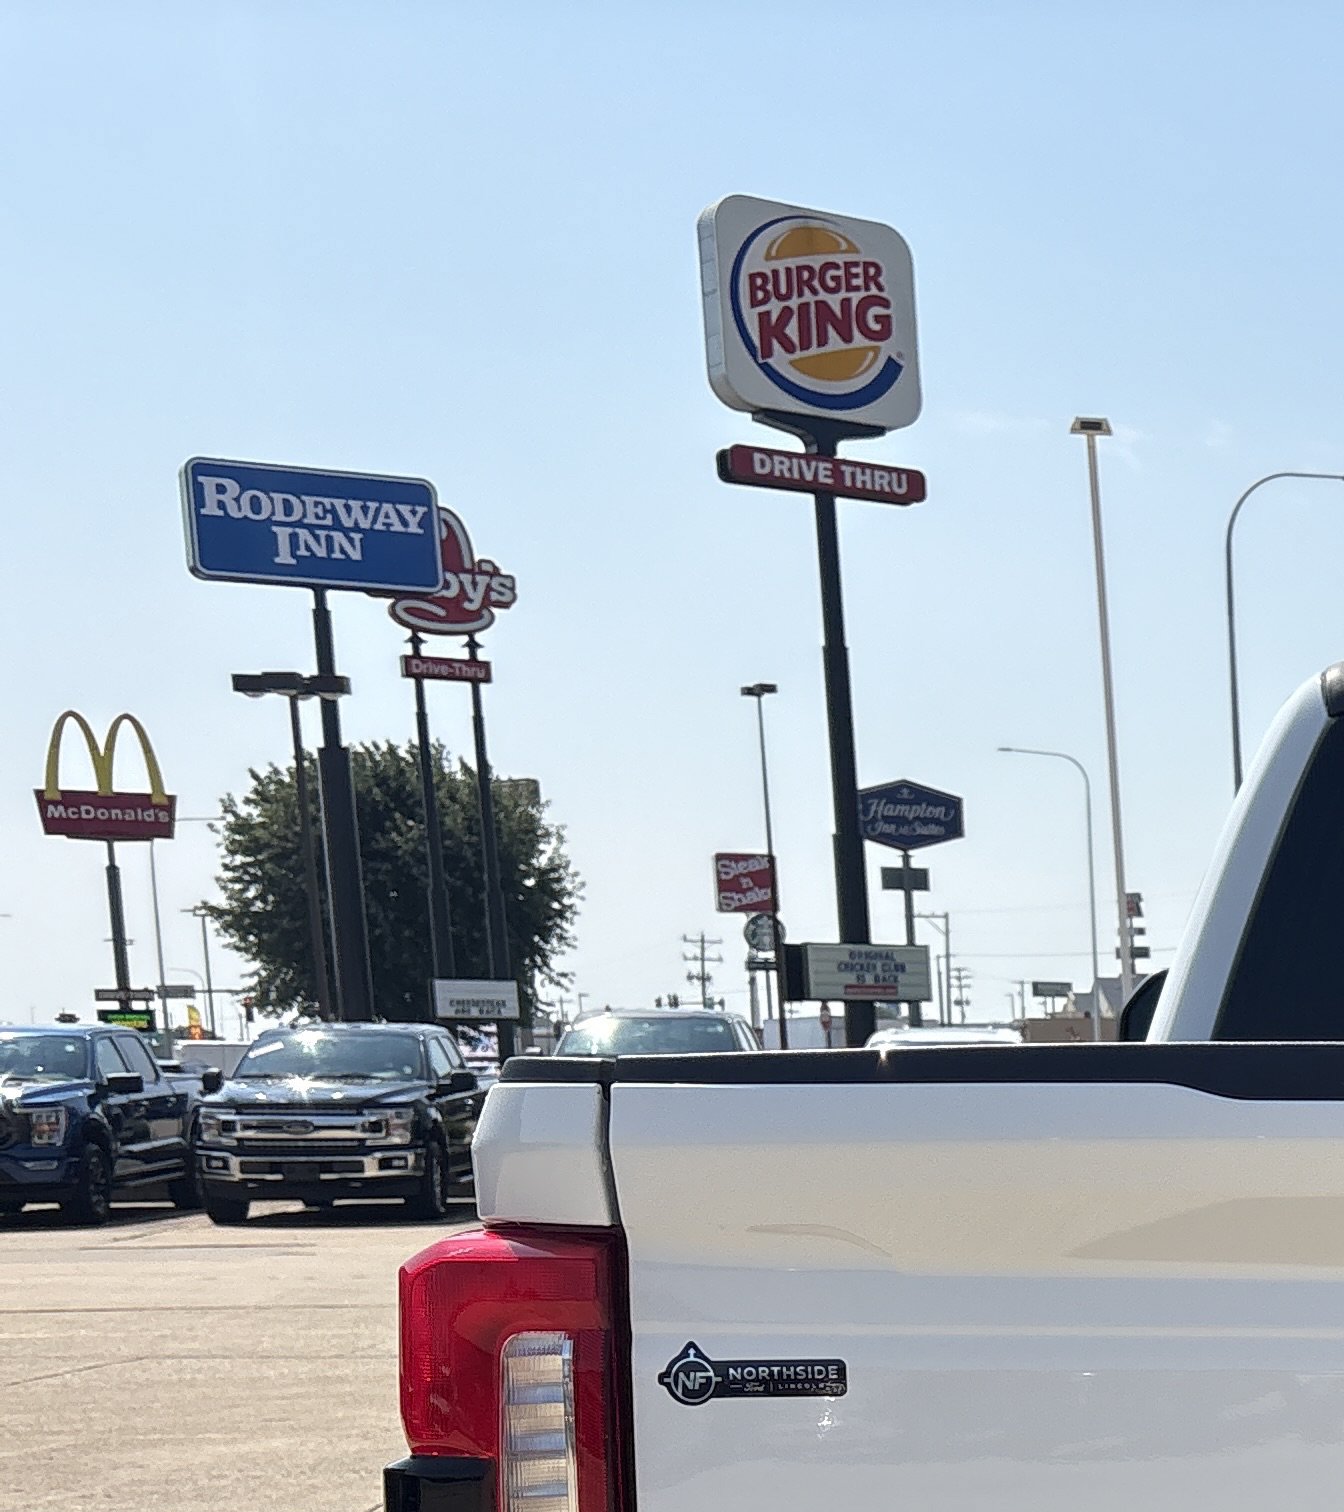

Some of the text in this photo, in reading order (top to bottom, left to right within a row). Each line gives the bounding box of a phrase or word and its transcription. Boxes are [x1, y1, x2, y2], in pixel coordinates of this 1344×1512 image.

[748, 261, 885, 309] BURGER
[757, 294, 893, 360] KING
[752, 452, 908, 495] DRIVE THRU
[197, 475, 429, 535] RODEWAY
[272, 525, 363, 566] INN
[411, 660, 486, 679] Drive-Thru
[46, 804, 170, 823] McDonald's
[862, 798, 955, 821] Hampton
[728, 1365, 839, 1381] NORTHSIDE
